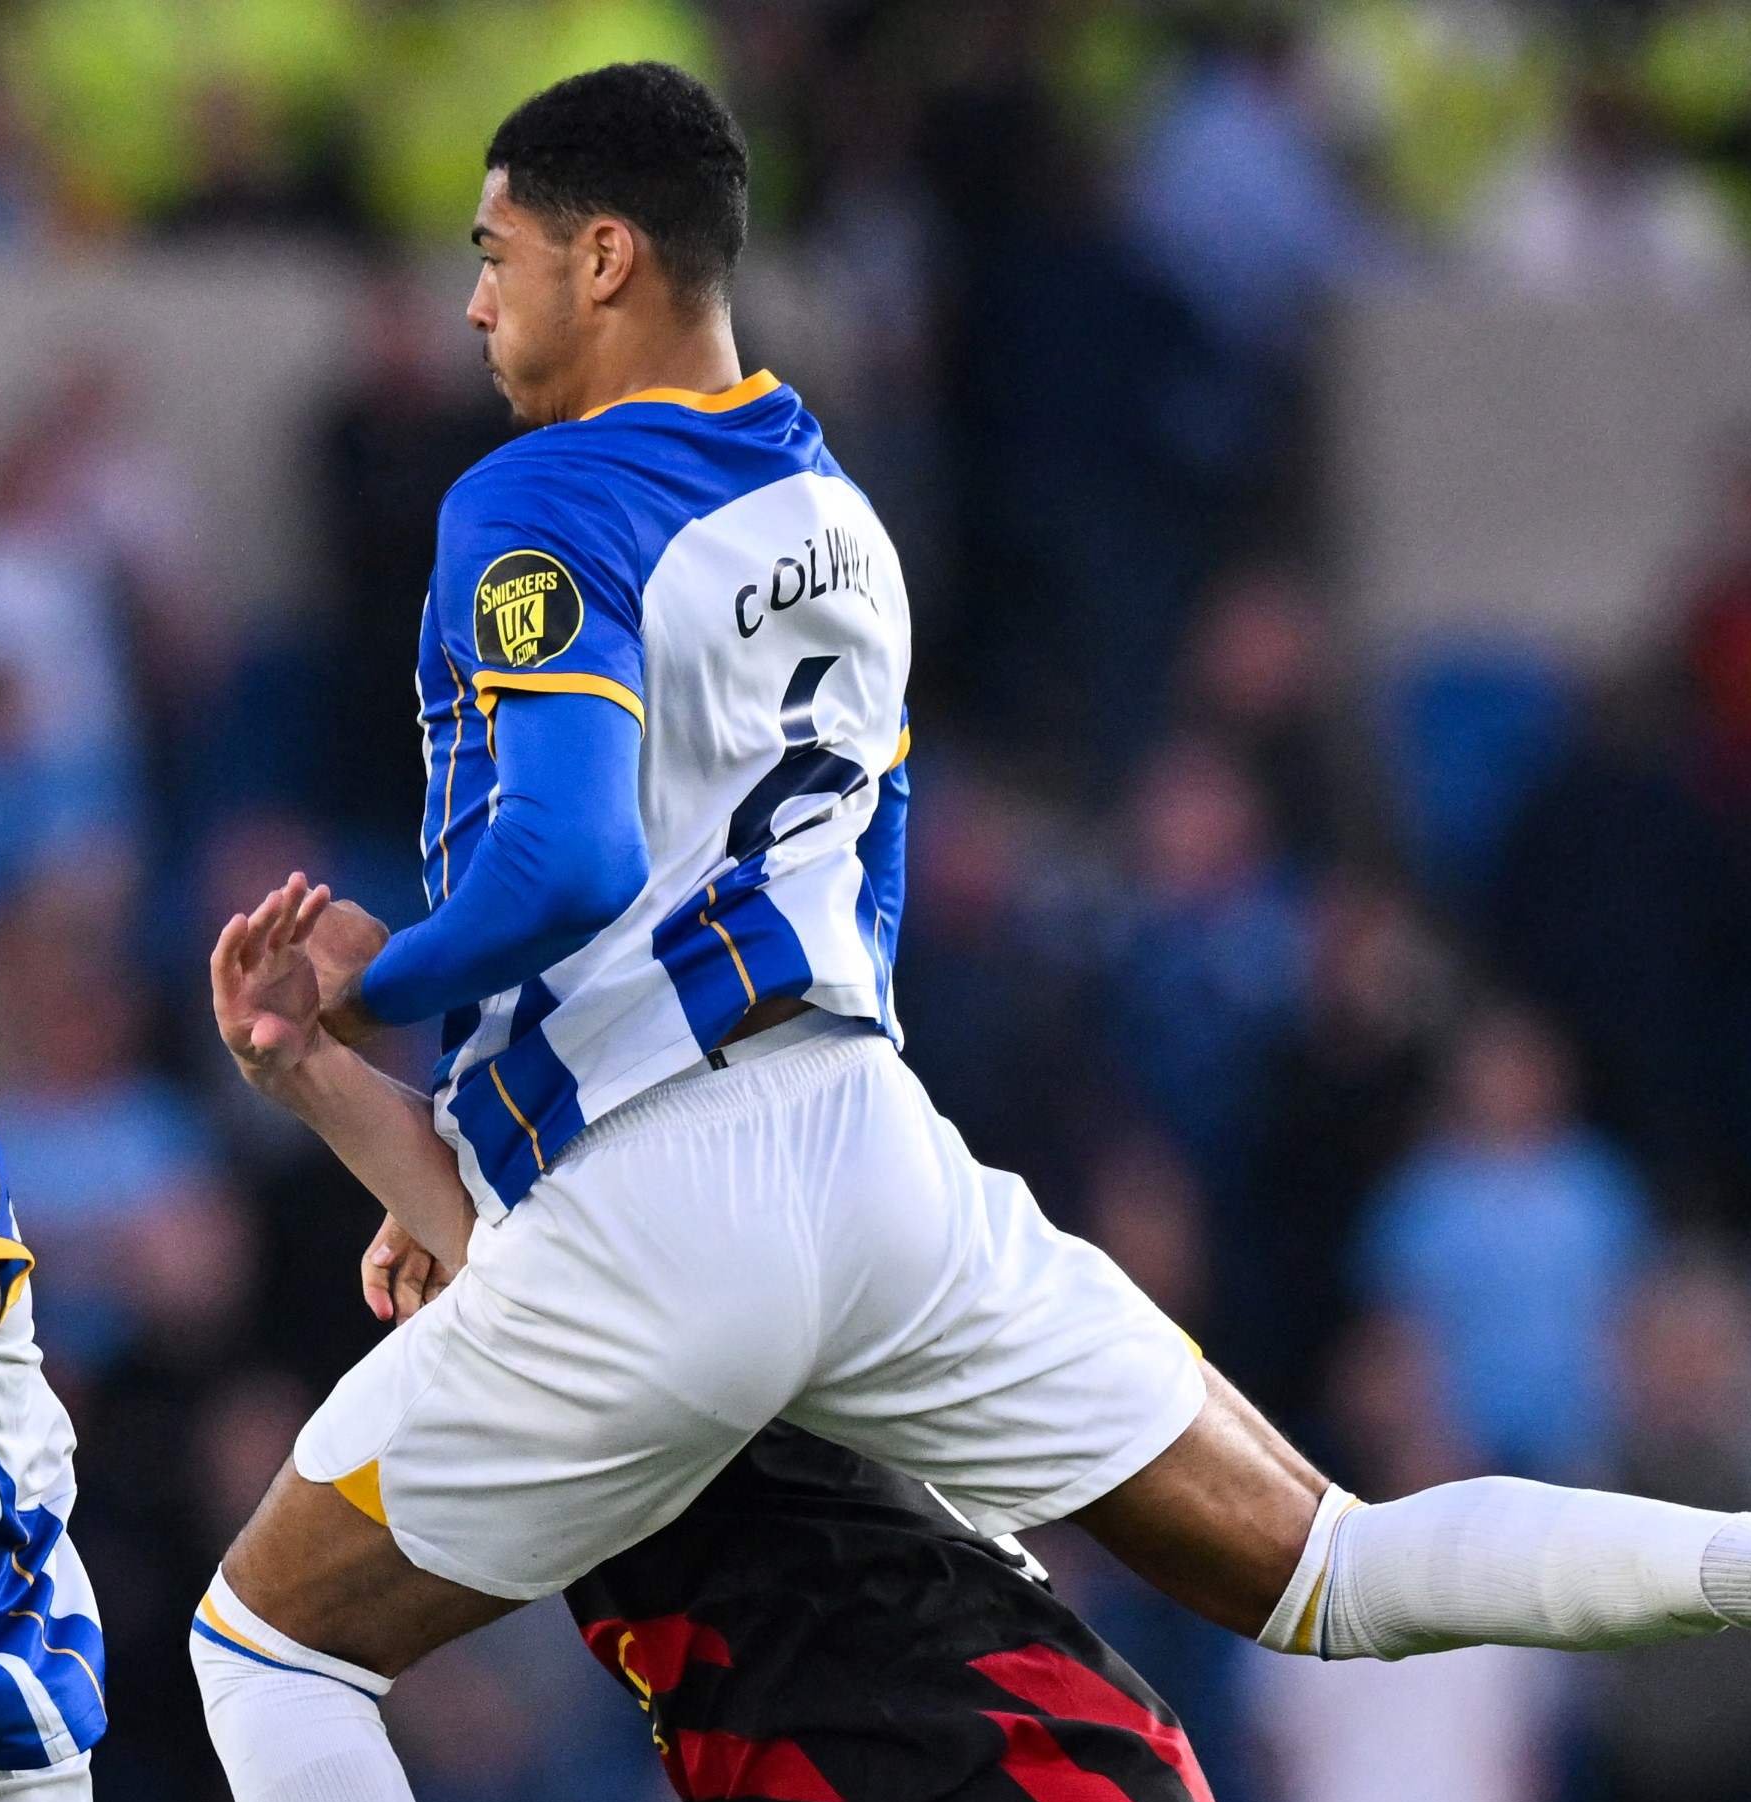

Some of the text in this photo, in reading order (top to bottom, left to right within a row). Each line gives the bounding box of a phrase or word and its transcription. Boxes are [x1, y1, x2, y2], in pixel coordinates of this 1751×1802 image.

[480, 571, 558, 615] SNICKERS
[501, 599, 537, 646] UK
[512, 640, 538, 668] .COM
[726, 655, 869, 866] 6
